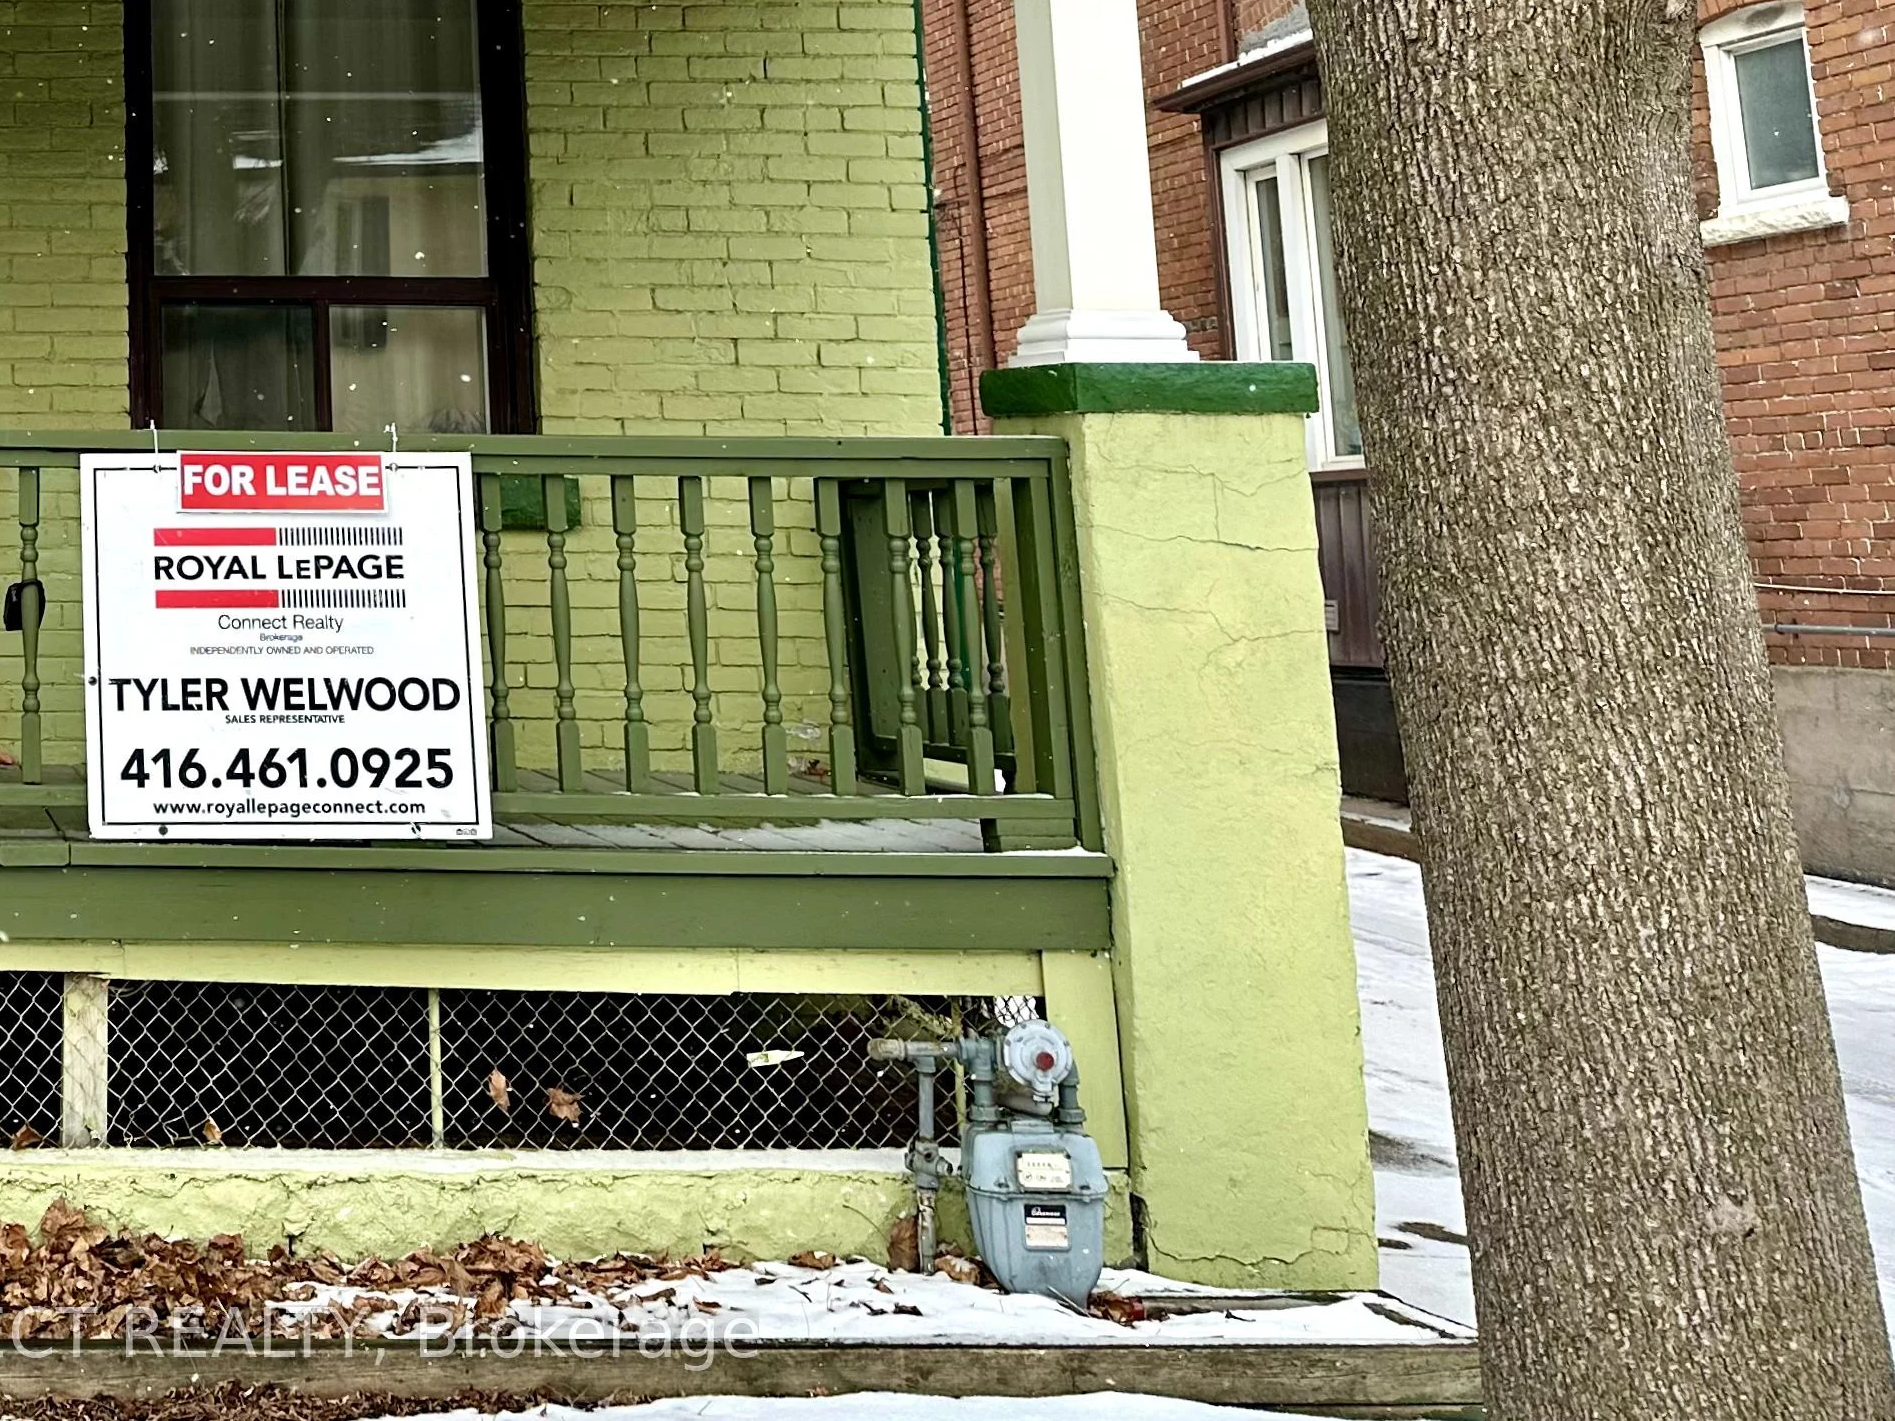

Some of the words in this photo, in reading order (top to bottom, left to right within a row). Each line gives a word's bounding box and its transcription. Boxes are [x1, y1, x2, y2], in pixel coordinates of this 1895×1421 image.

[183, 464, 257, 496] FOR
[265, 464, 381, 497] LEASE
[154, 554, 267, 580] ROYAL
[218, 614, 287, 630] Connect
[292, 614, 344, 634] Realty
[259, 632, 304, 643] Brokerage
[190, 645, 264, 655] INDEPENDENTLY
[265, 645, 301, 655] OWNED
[303, 645, 323, 655] AND
[325, 645, 375, 655] OPERATED
[108, 677, 230, 712] TYLER
[240, 676, 461, 712] WELWOOD
[225, 714, 256, 724] SALES
[259, 714, 346, 724] REPRESENTATIVE
[120, 746, 454, 789] 416.461.0925
[153, 797, 426, 819] www.royallepageconnect.com
